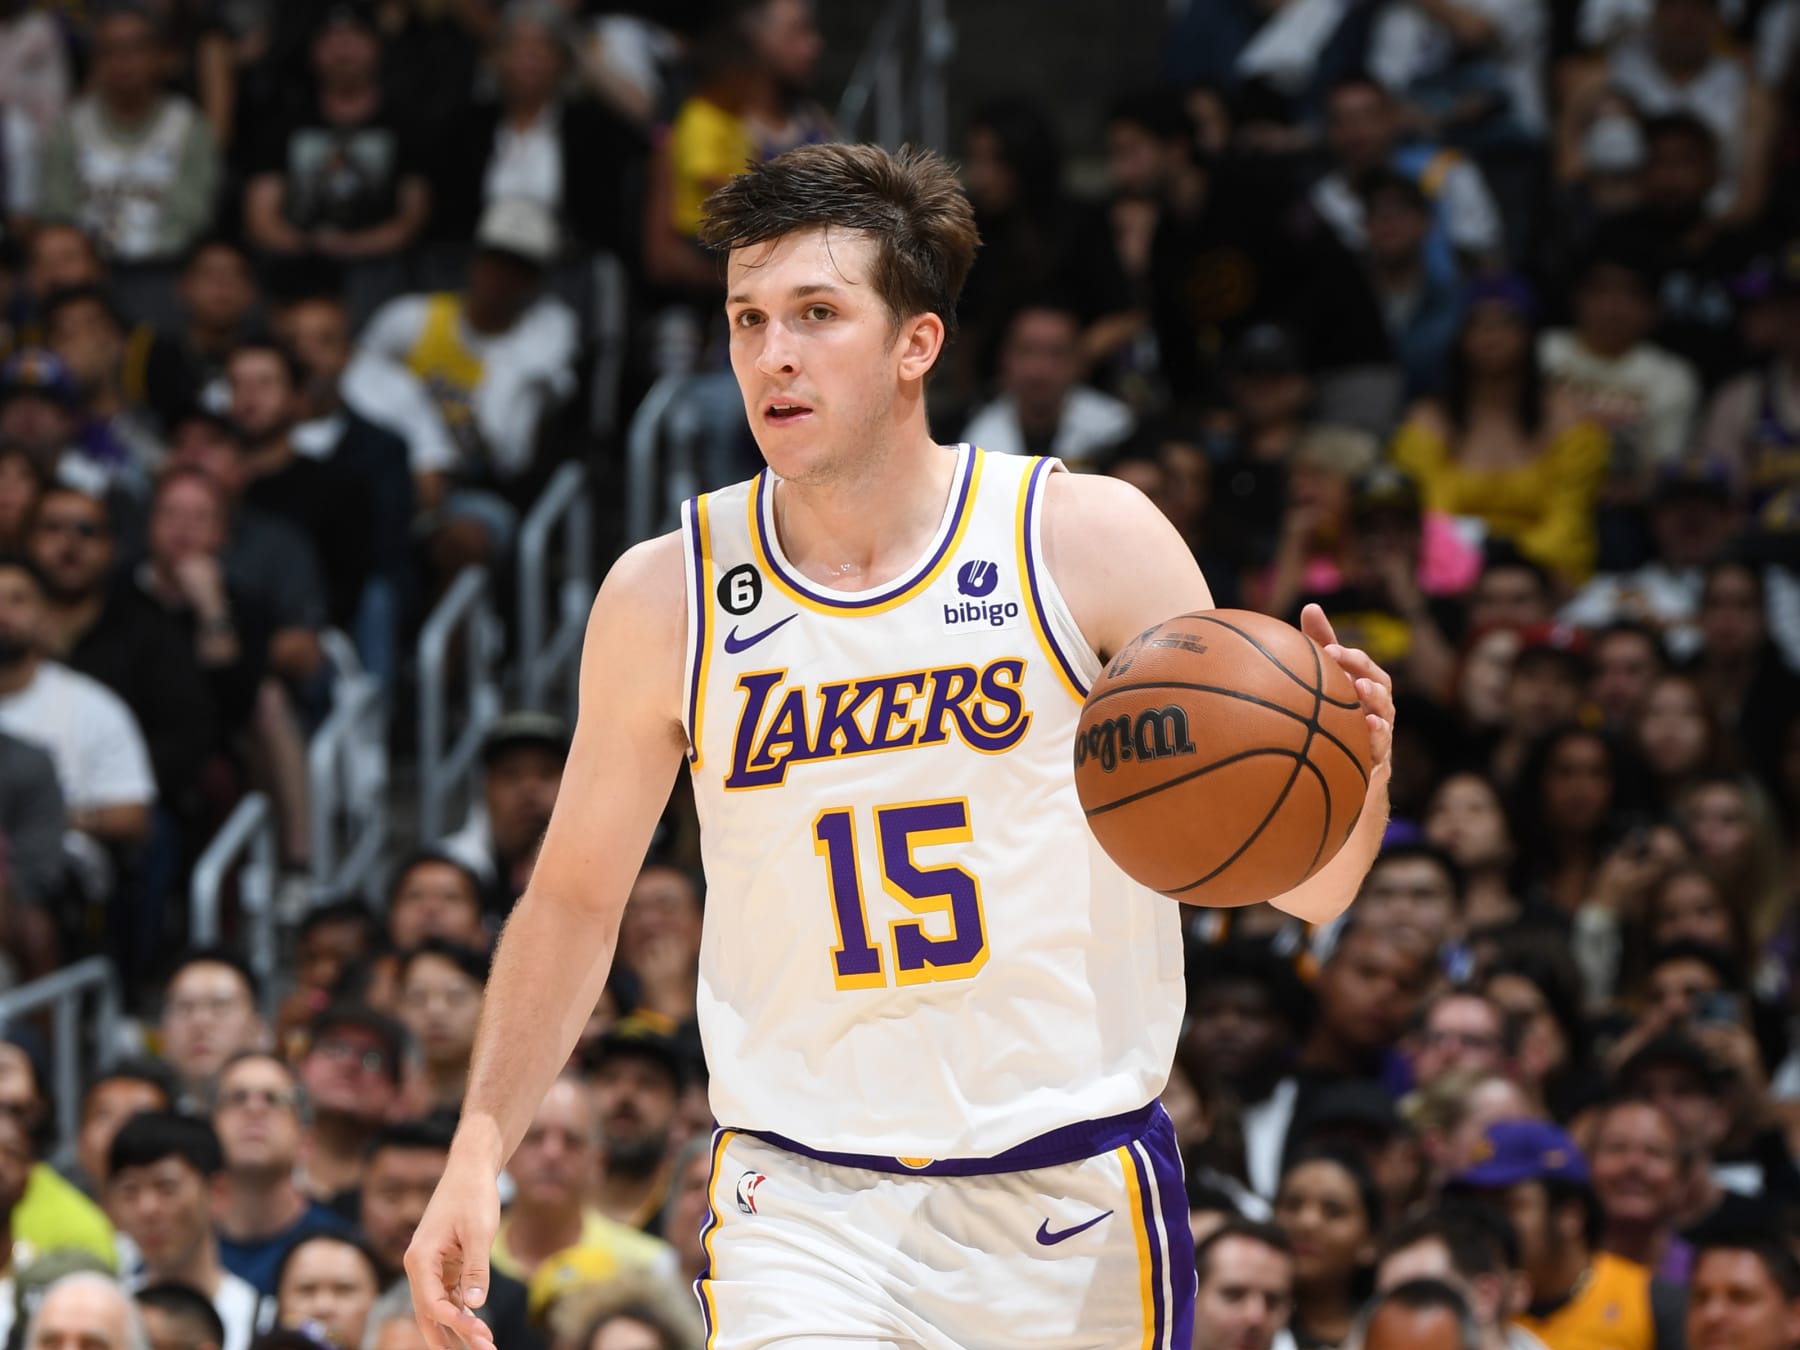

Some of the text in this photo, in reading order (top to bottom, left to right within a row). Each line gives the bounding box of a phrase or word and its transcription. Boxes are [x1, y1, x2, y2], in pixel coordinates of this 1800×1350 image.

[730, 571, 754, 610] 6
[943, 601, 1018, 626] bibigo
[723, 656, 1034, 792] LAKERS
[1074, 704, 1196, 772] Wilso
[811, 796, 991, 991] 15
